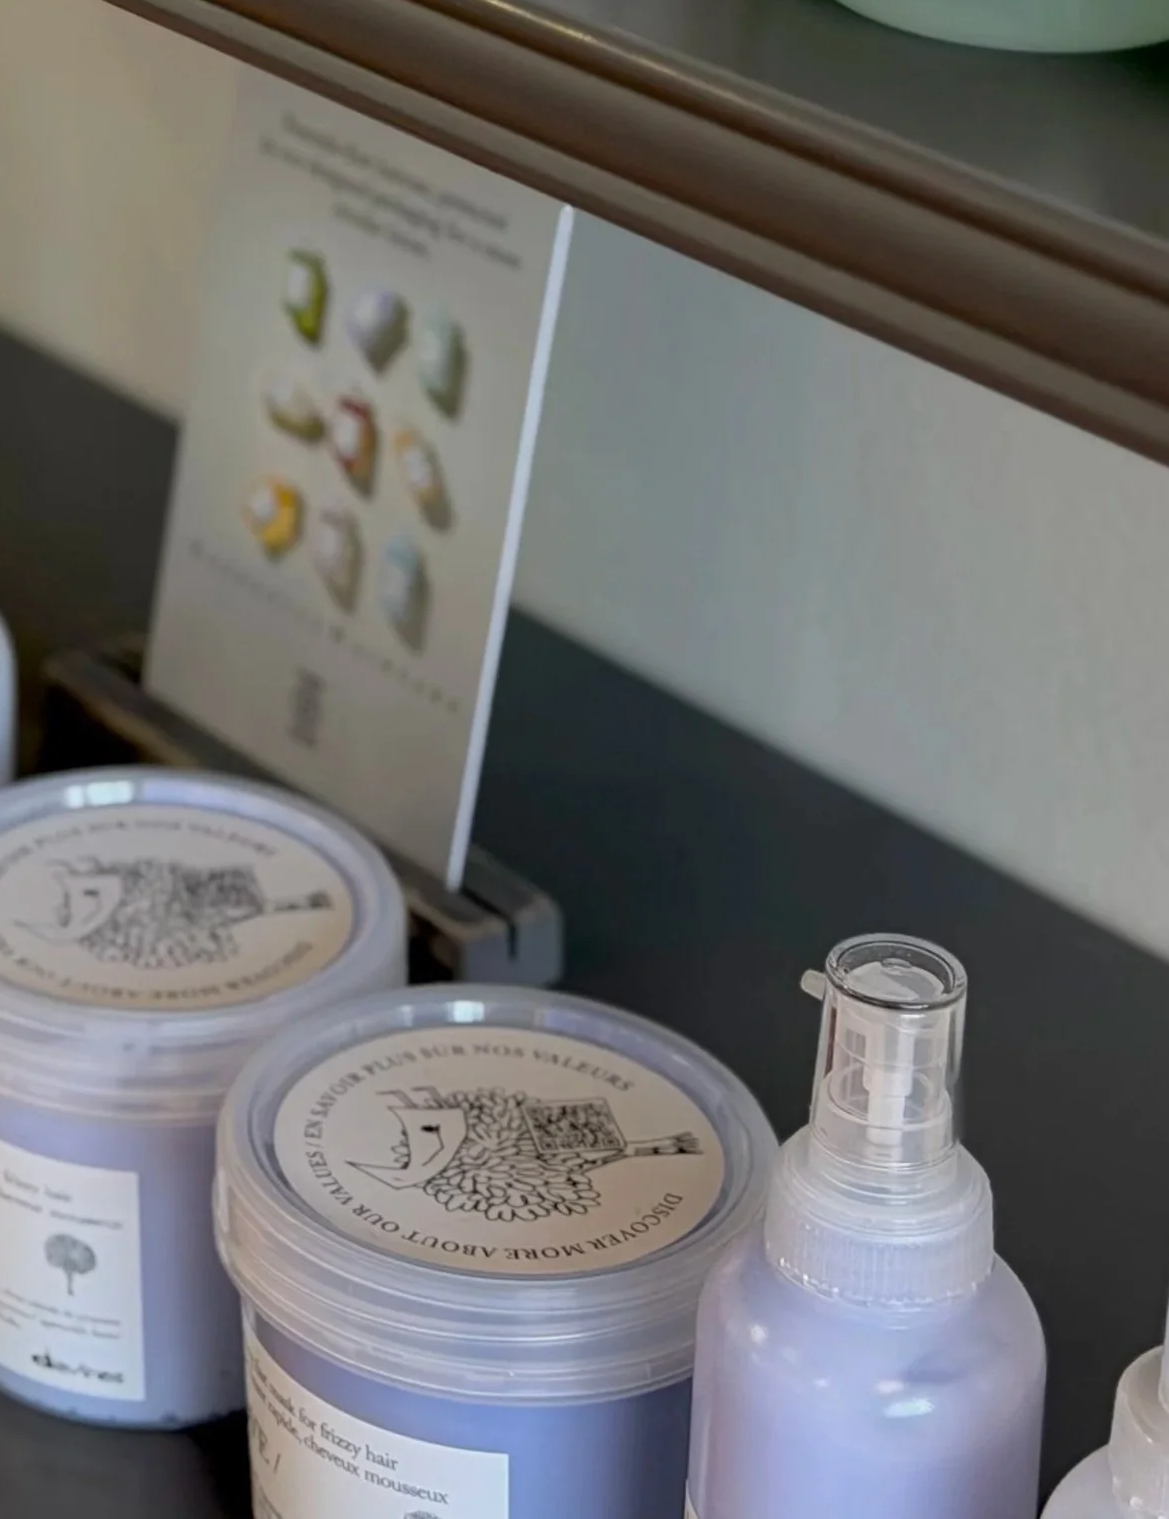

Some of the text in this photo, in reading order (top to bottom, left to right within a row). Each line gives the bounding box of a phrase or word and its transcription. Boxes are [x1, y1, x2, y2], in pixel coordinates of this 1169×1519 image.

[360, 1049, 418, 1076] PLUS
[418, 1044, 466, 1060] SUR
[472, 1044, 525, 1059] NOS
[532, 1048, 636, 1093] VALEURS
[310, 1071, 366, 1119] SAVOIR
[303, 1119, 325, 1140] EN
[305, 1149, 356, 1207] VALUES
[351, 1202, 401, 1233] OUR
[586, 1192, 684, 1251] DISCOVER
[401, 1230, 498, 1259] ABOUT
[504, 1242, 587, 1261] MORE
[319, 1422, 363, 1458] frizzy
[365, 1444, 400, 1473] hair
[303, 1434, 361, 1477] cheveux
[363, 1467, 450, 1505] mousseux
